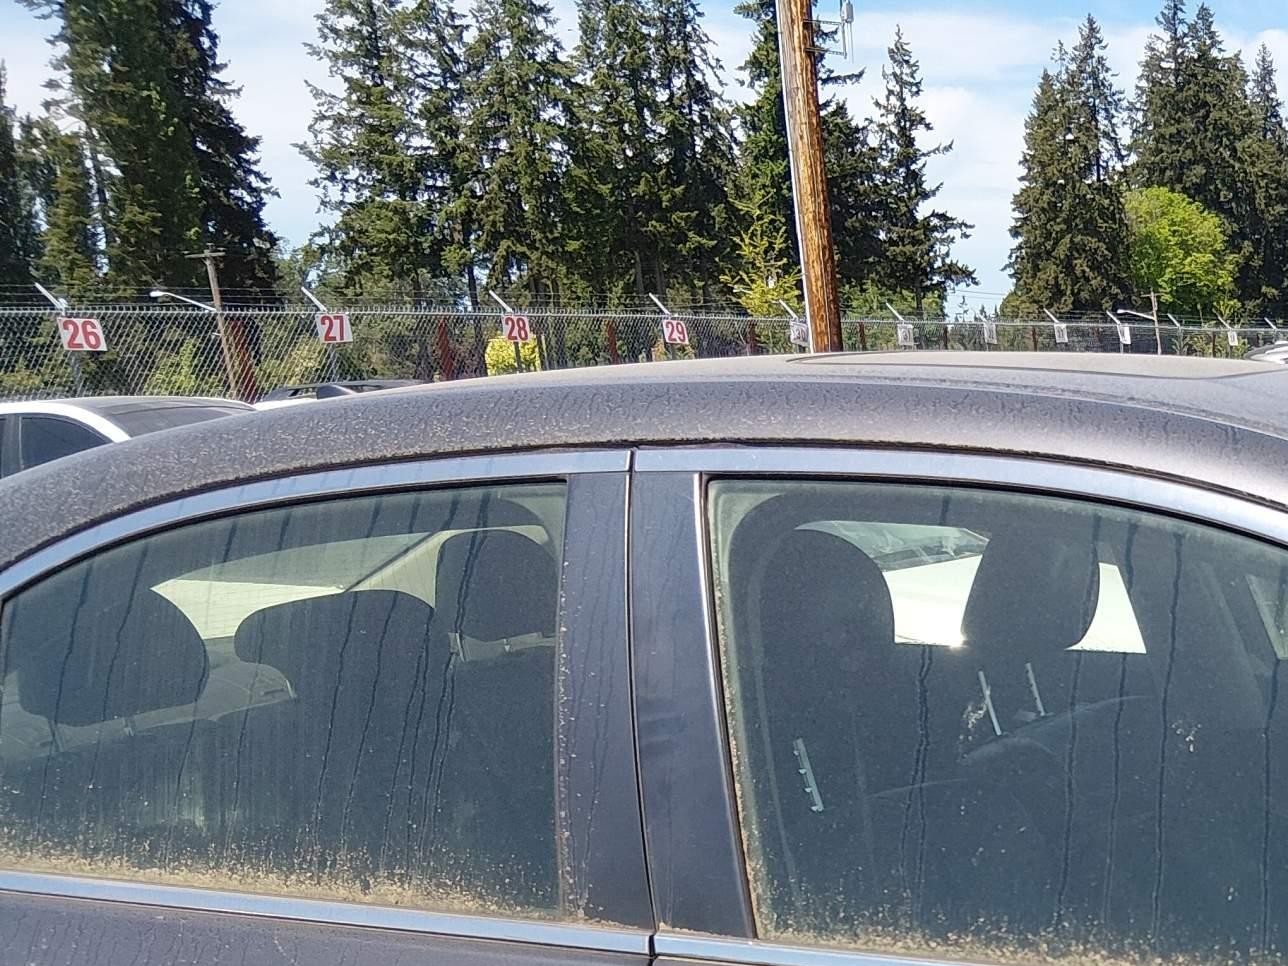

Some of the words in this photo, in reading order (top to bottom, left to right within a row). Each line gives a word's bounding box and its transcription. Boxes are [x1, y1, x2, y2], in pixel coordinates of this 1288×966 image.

[62, 319, 102, 350] 26
[320, 315, 345, 342] 27
[504, 316, 529, 341] 28
[665, 321, 686, 343] 29
